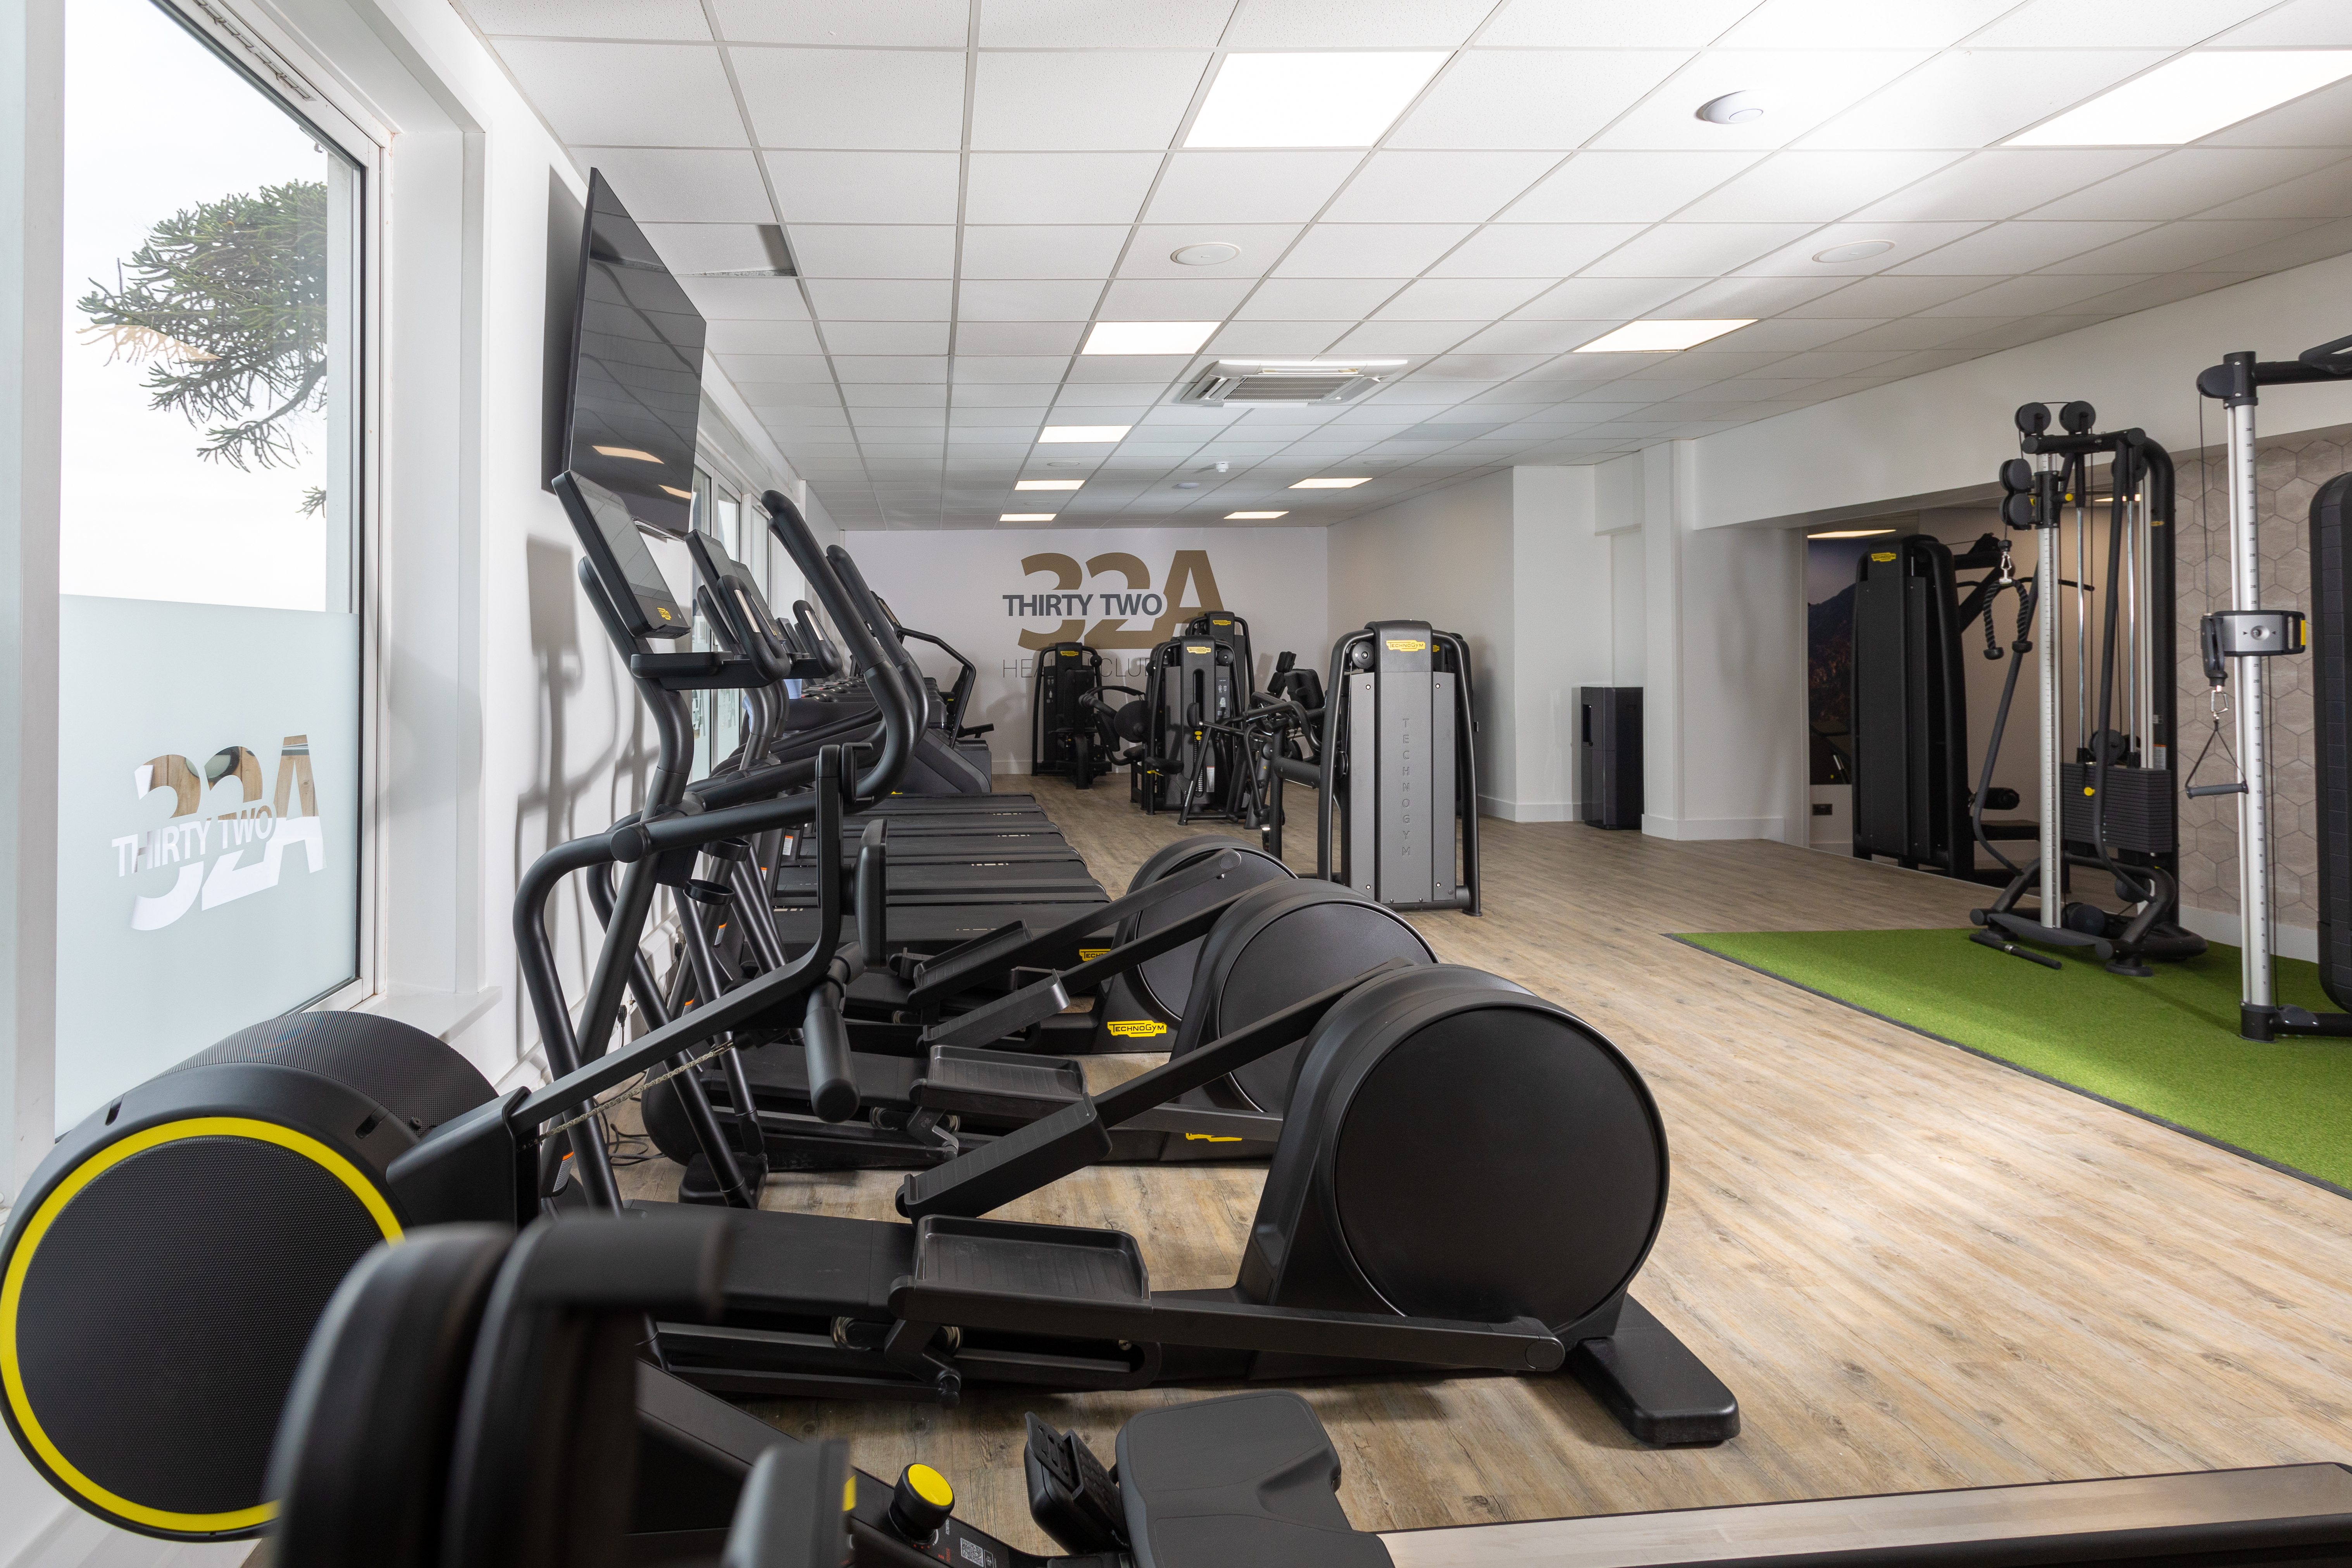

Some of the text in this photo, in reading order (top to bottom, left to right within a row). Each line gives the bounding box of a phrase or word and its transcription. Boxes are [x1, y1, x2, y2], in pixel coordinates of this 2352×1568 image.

[1003, 593, 1162, 616] THIRTY TWO
[131, 734, 327, 930] 32A
[1403, 718, 1411, 856] TECHNOGYM
[112, 805, 272, 877] THIRTY TWO
